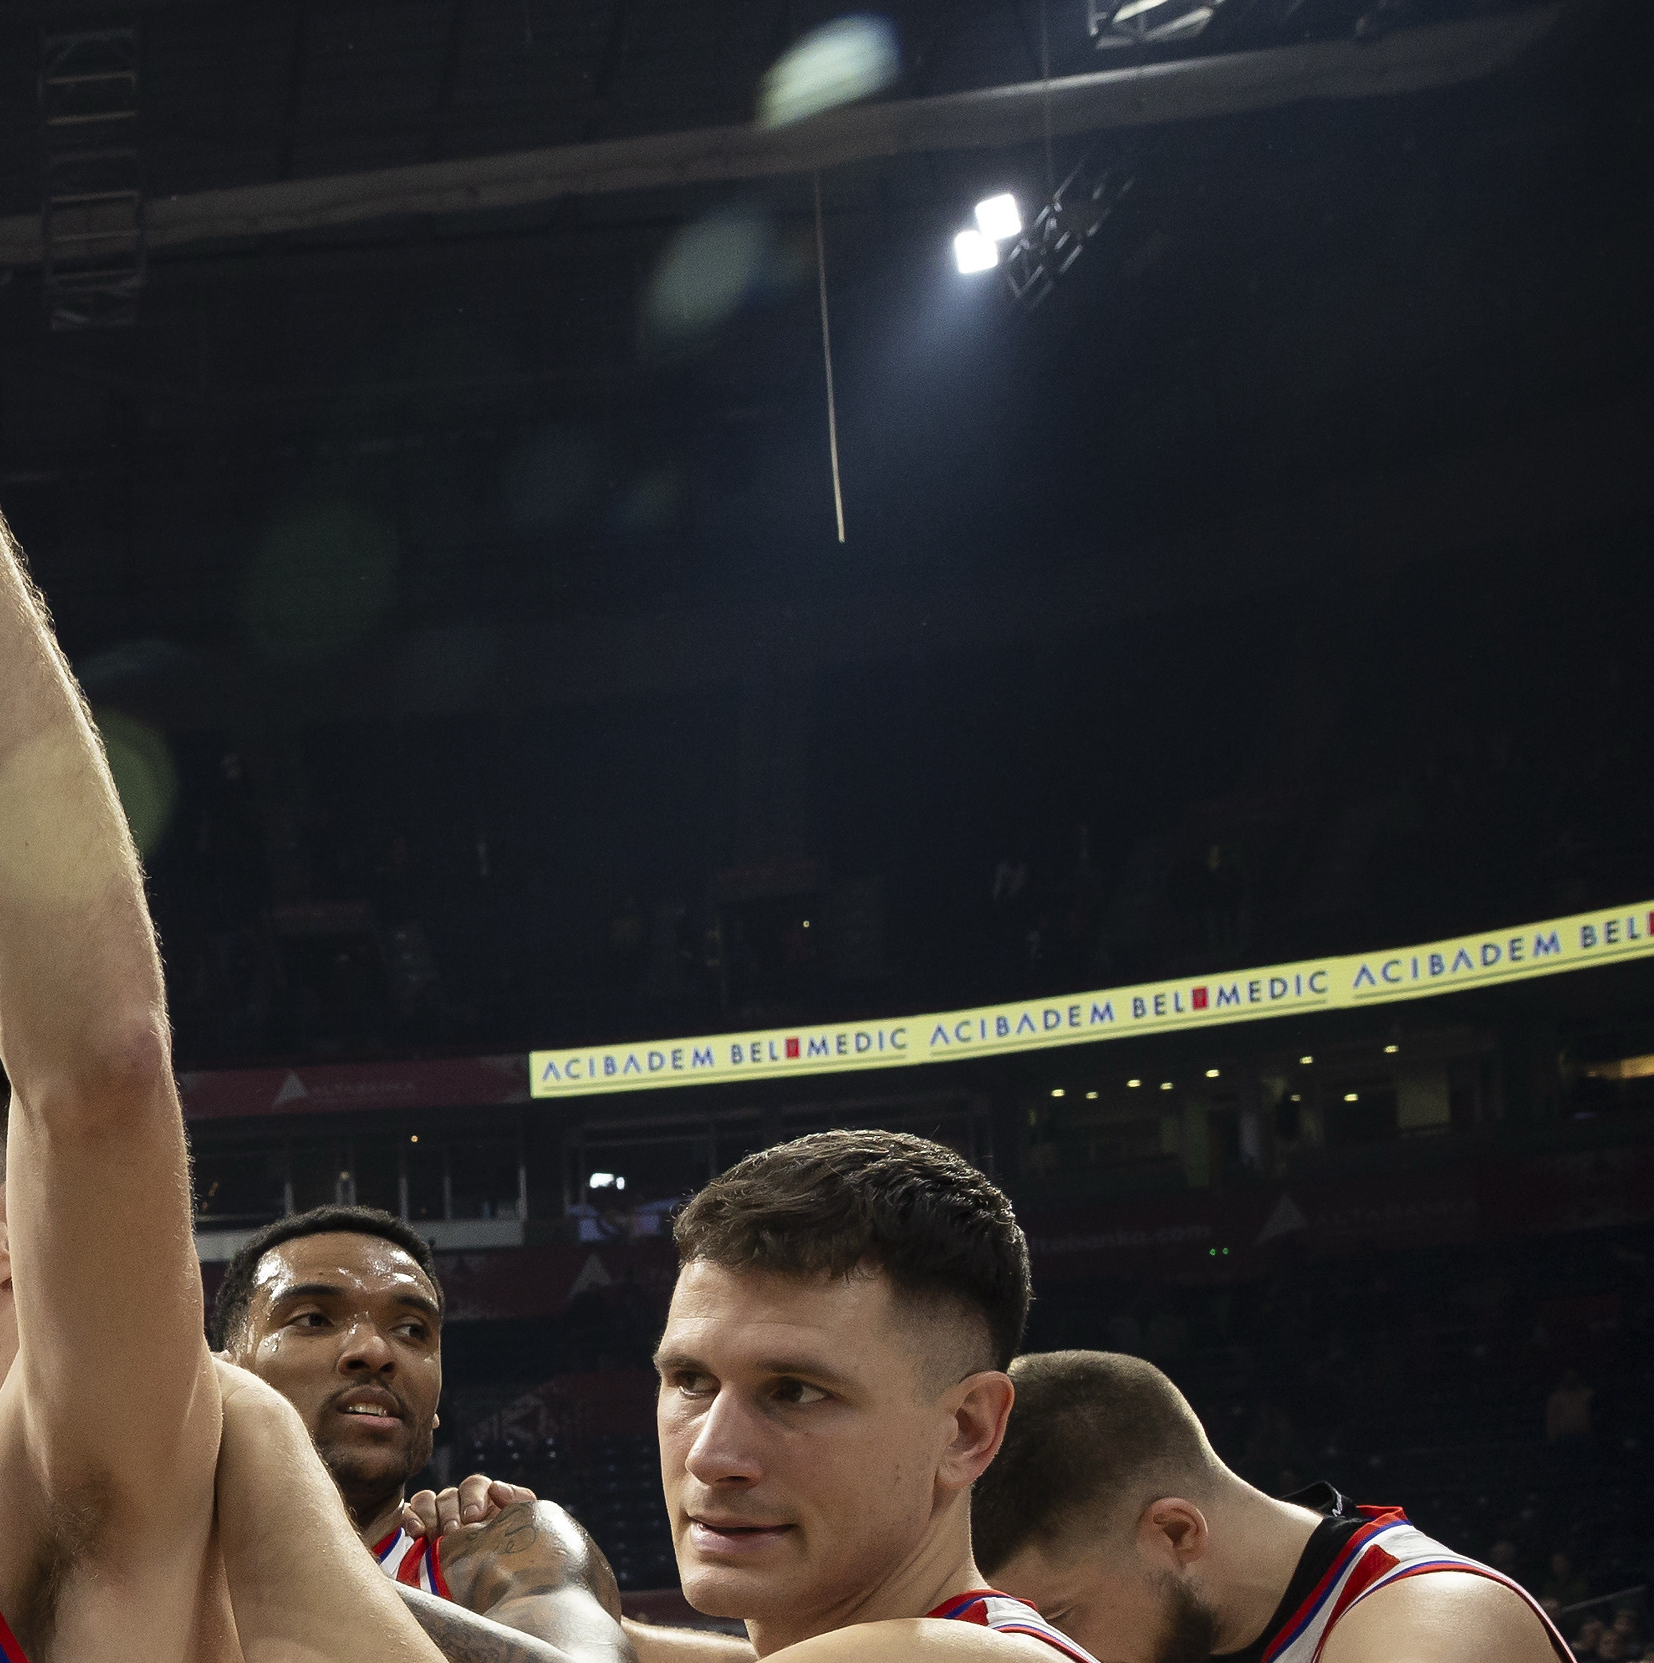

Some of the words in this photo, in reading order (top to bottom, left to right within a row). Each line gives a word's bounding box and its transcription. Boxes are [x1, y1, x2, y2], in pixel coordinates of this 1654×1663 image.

[1352, 931, 1562, 990] ACIBADEM
[930, 1000, 1115, 1046] ACIBADEM
[541, 1045, 715, 1081] ACIBADEM
